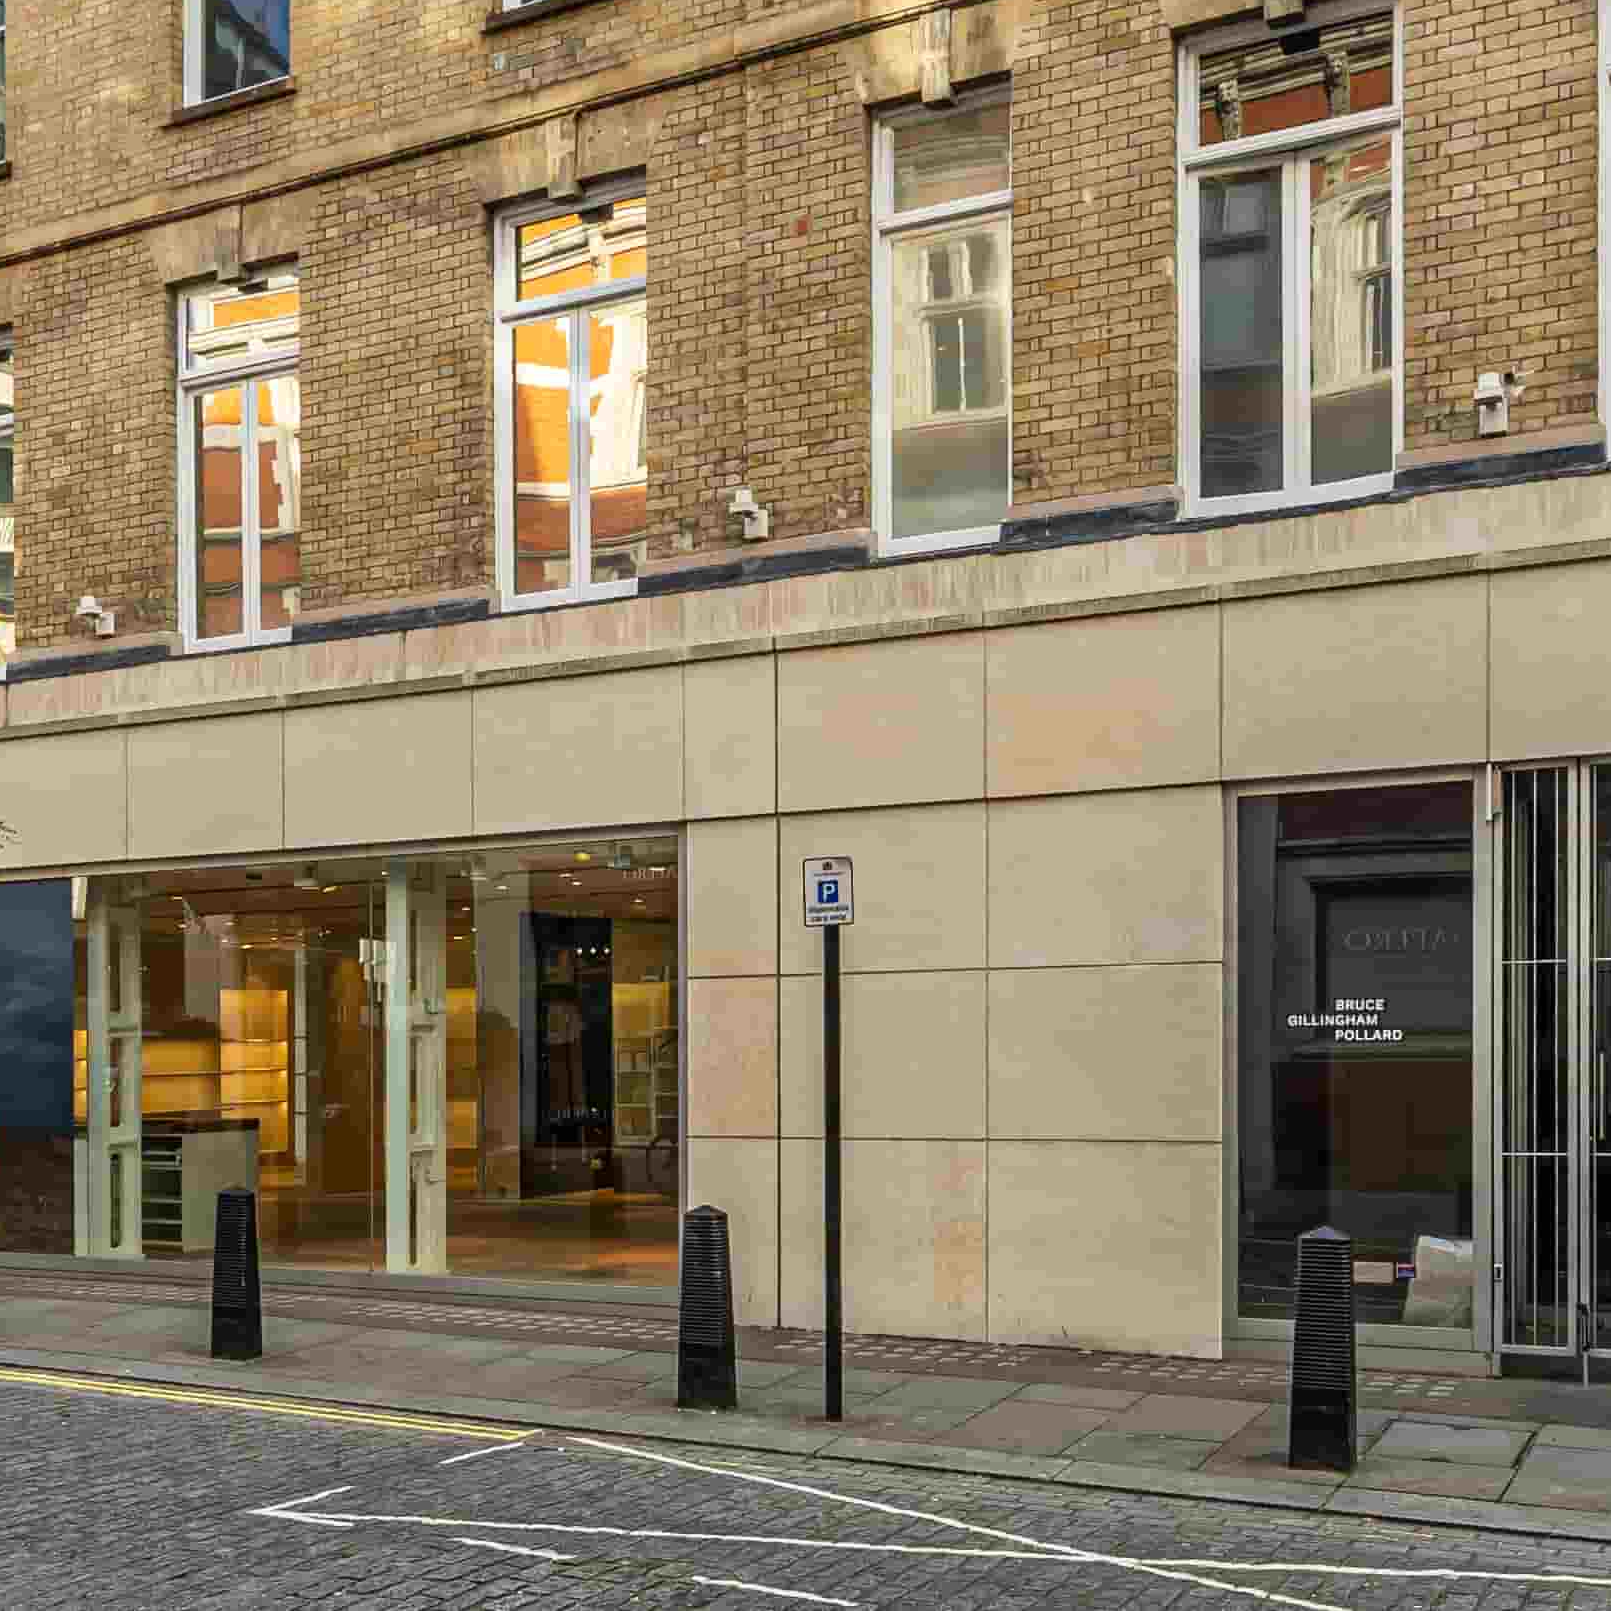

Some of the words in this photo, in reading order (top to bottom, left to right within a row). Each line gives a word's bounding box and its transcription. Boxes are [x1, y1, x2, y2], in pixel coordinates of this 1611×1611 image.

[1335, 998, 1385, 1011] BRUCE
[1287, 1014, 1378, 1027] GILLINGHAM
[1335, 1029, 1403, 1042] POLLARD
